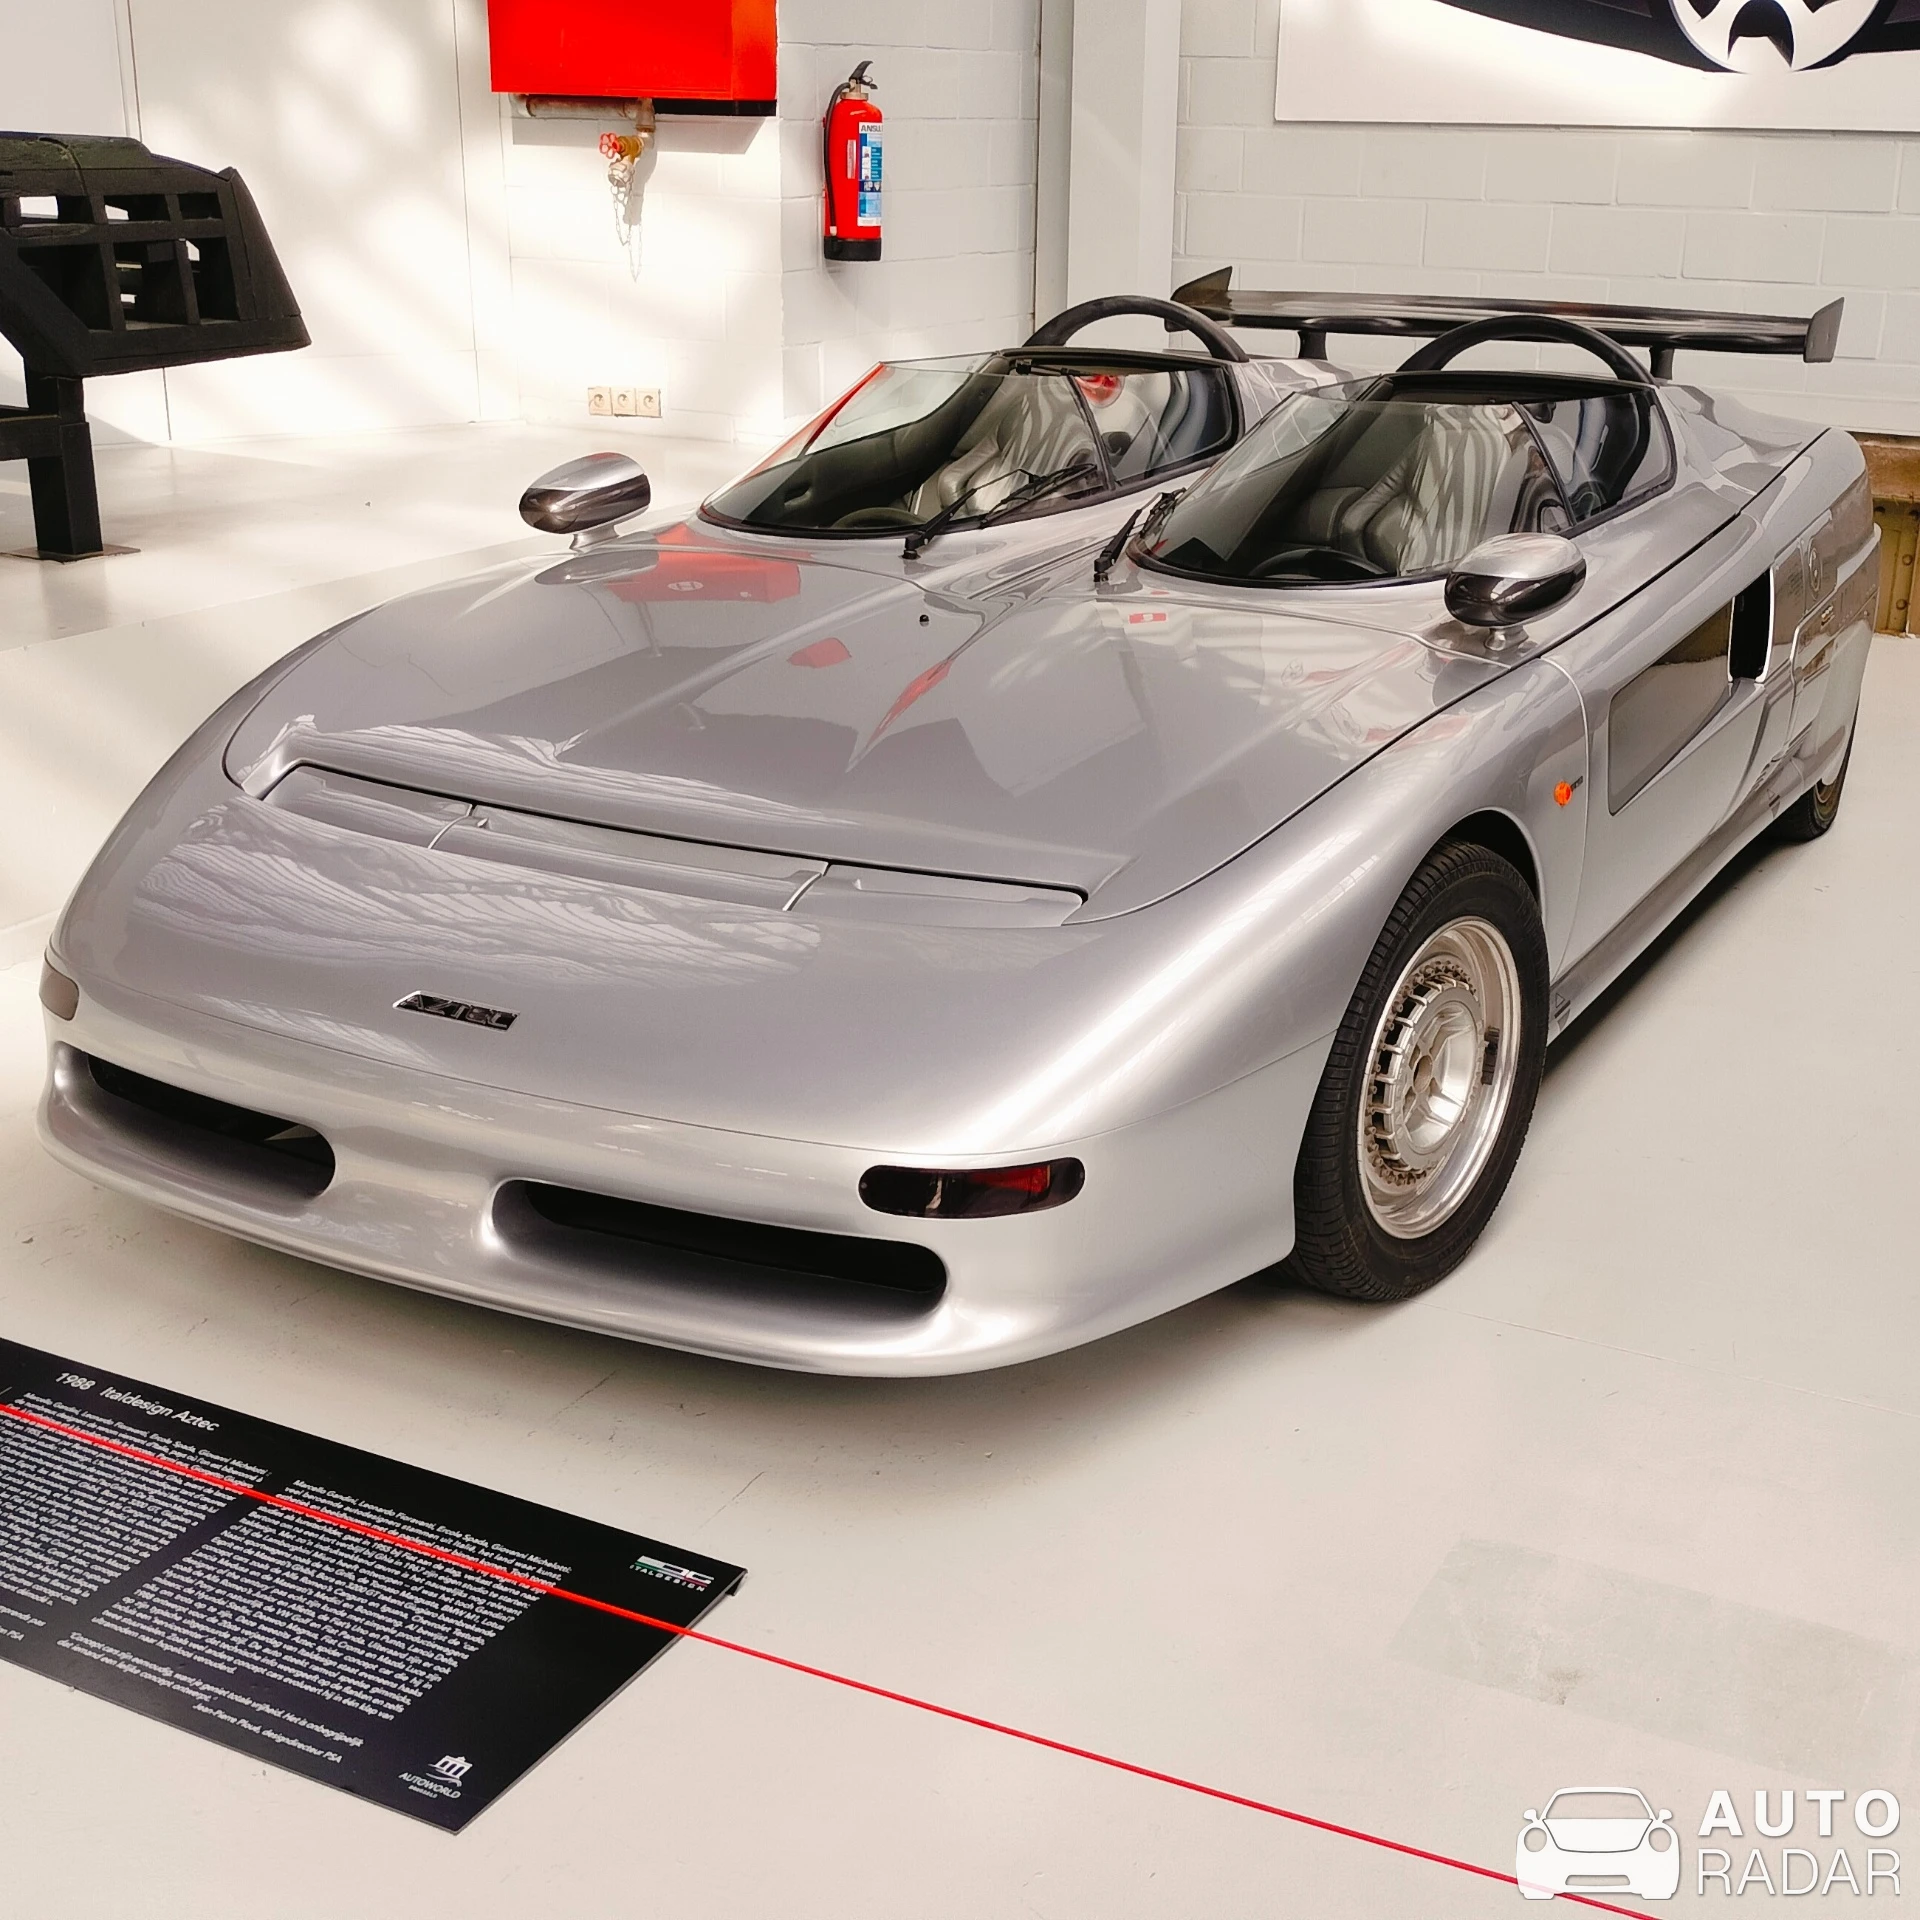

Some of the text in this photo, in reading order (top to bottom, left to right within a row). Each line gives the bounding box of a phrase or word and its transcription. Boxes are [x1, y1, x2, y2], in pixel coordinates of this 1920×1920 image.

[55, 1372, 220, 1432] 1988 Italdesign Aztec
[398, 1772, 461, 1799] AUTOWORLD
